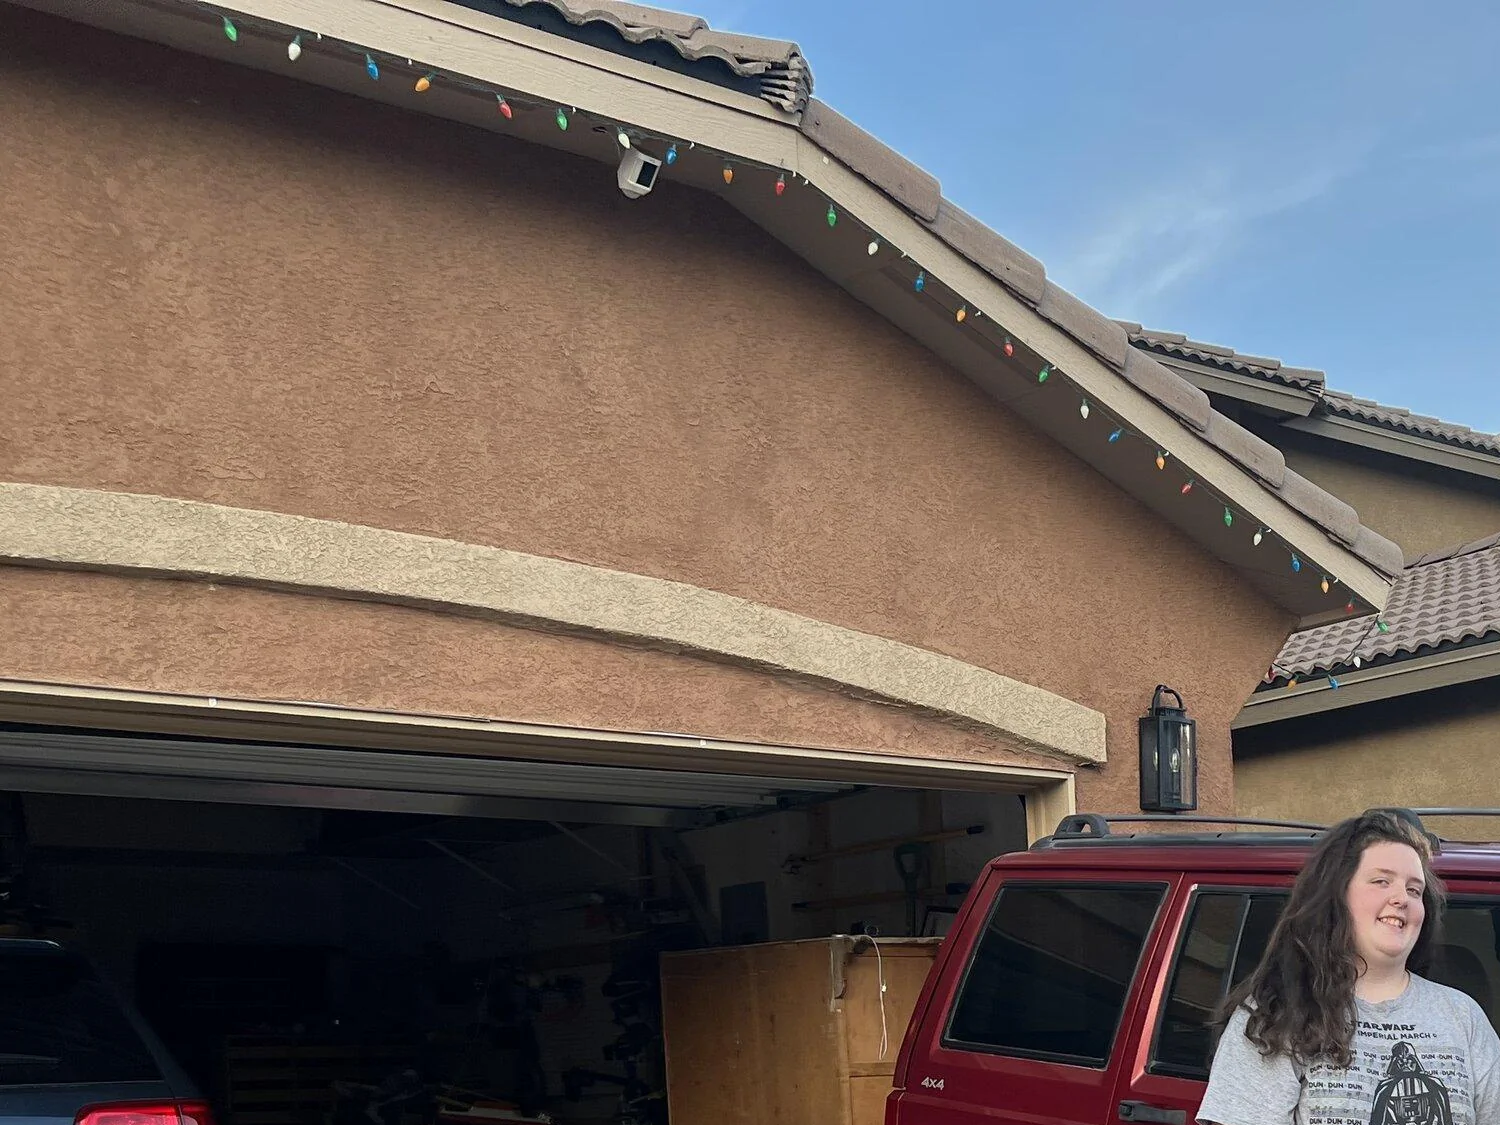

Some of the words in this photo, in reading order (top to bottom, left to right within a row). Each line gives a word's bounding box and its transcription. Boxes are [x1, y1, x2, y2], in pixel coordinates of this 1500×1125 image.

[1356, 1021, 1382, 1030] TAR
[1381, 1023, 1416, 1032] WARS
[1357, 1030, 1399, 1041] IMPERIAL
[1400, 1031, 1434, 1040] MARCH
[1308, 1081, 1324, 1089] DUN
[1347, 1083, 1363, 1091] DUN
[1326, 1117, 1343, 1125] DUN
[1346, 1118, 1362, 1125] DUN
